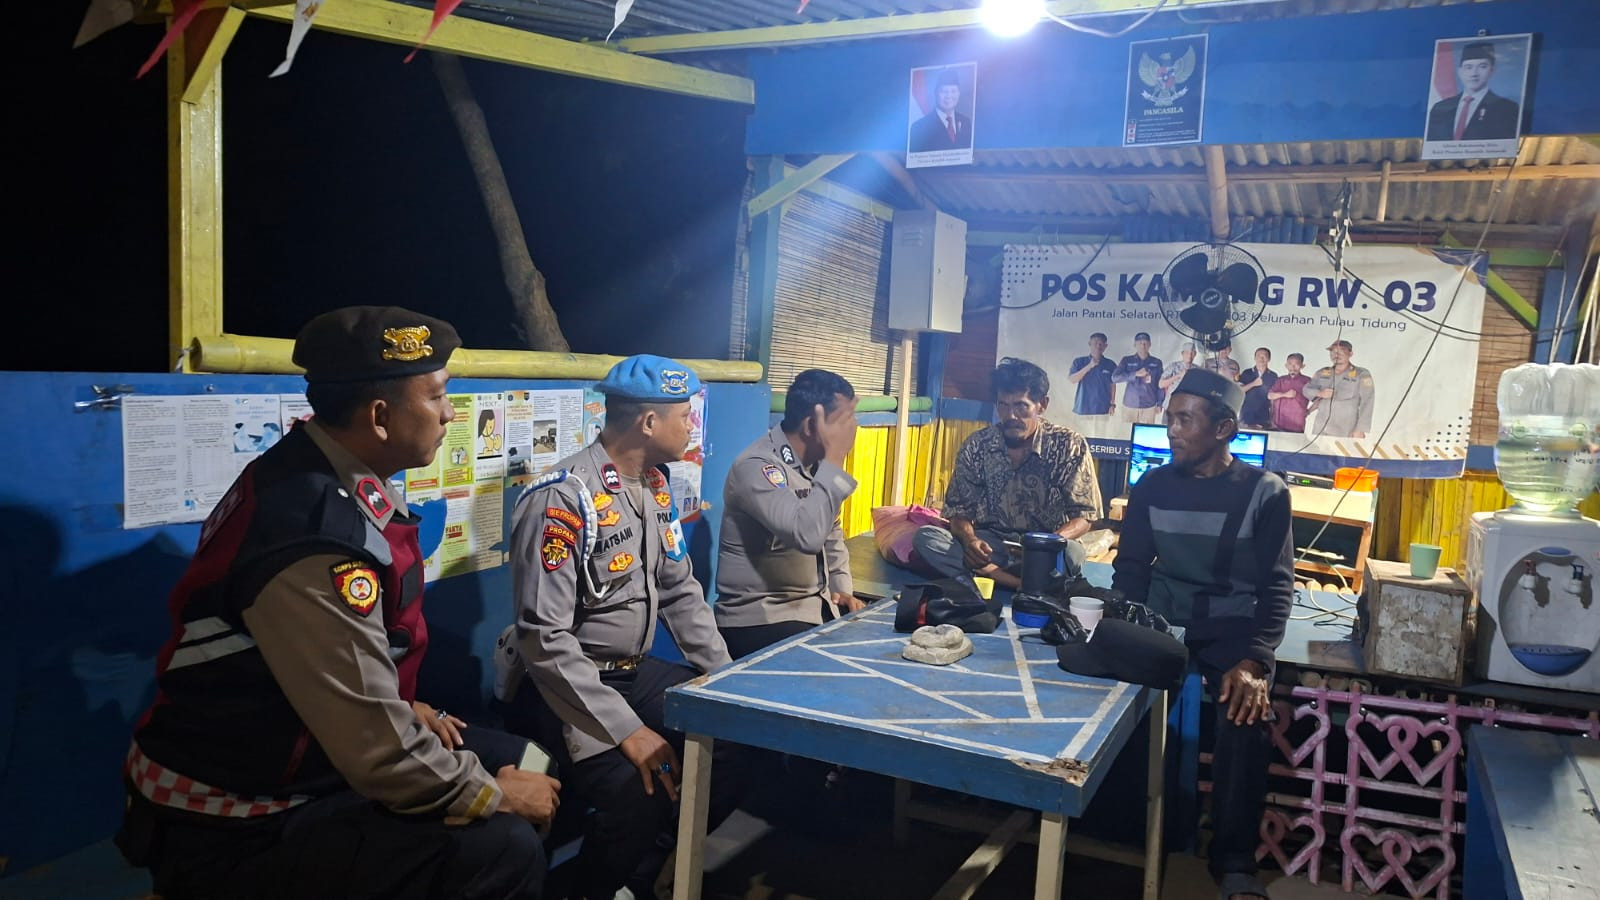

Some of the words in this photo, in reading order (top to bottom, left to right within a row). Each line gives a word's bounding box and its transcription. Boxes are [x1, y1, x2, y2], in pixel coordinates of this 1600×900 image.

[1143, 106, 1184, 116] PANCASILA
[1041, 272, 1107, 302] POS
[1296, 276, 1368, 309] RW.
[1383, 280, 1437, 312] 03
[1051, 308, 1079, 319] Jalan
[1082, 308, 1117, 320] Pantai
[1120, 308, 1162, 320] Selatan
[1251, 311, 1315, 326] Kelurahan
[1319, 315, 1355, 328] Pulau
[1360, 317, 1407, 332] Tidung
[1089, 444, 1122, 455] SERIBU
